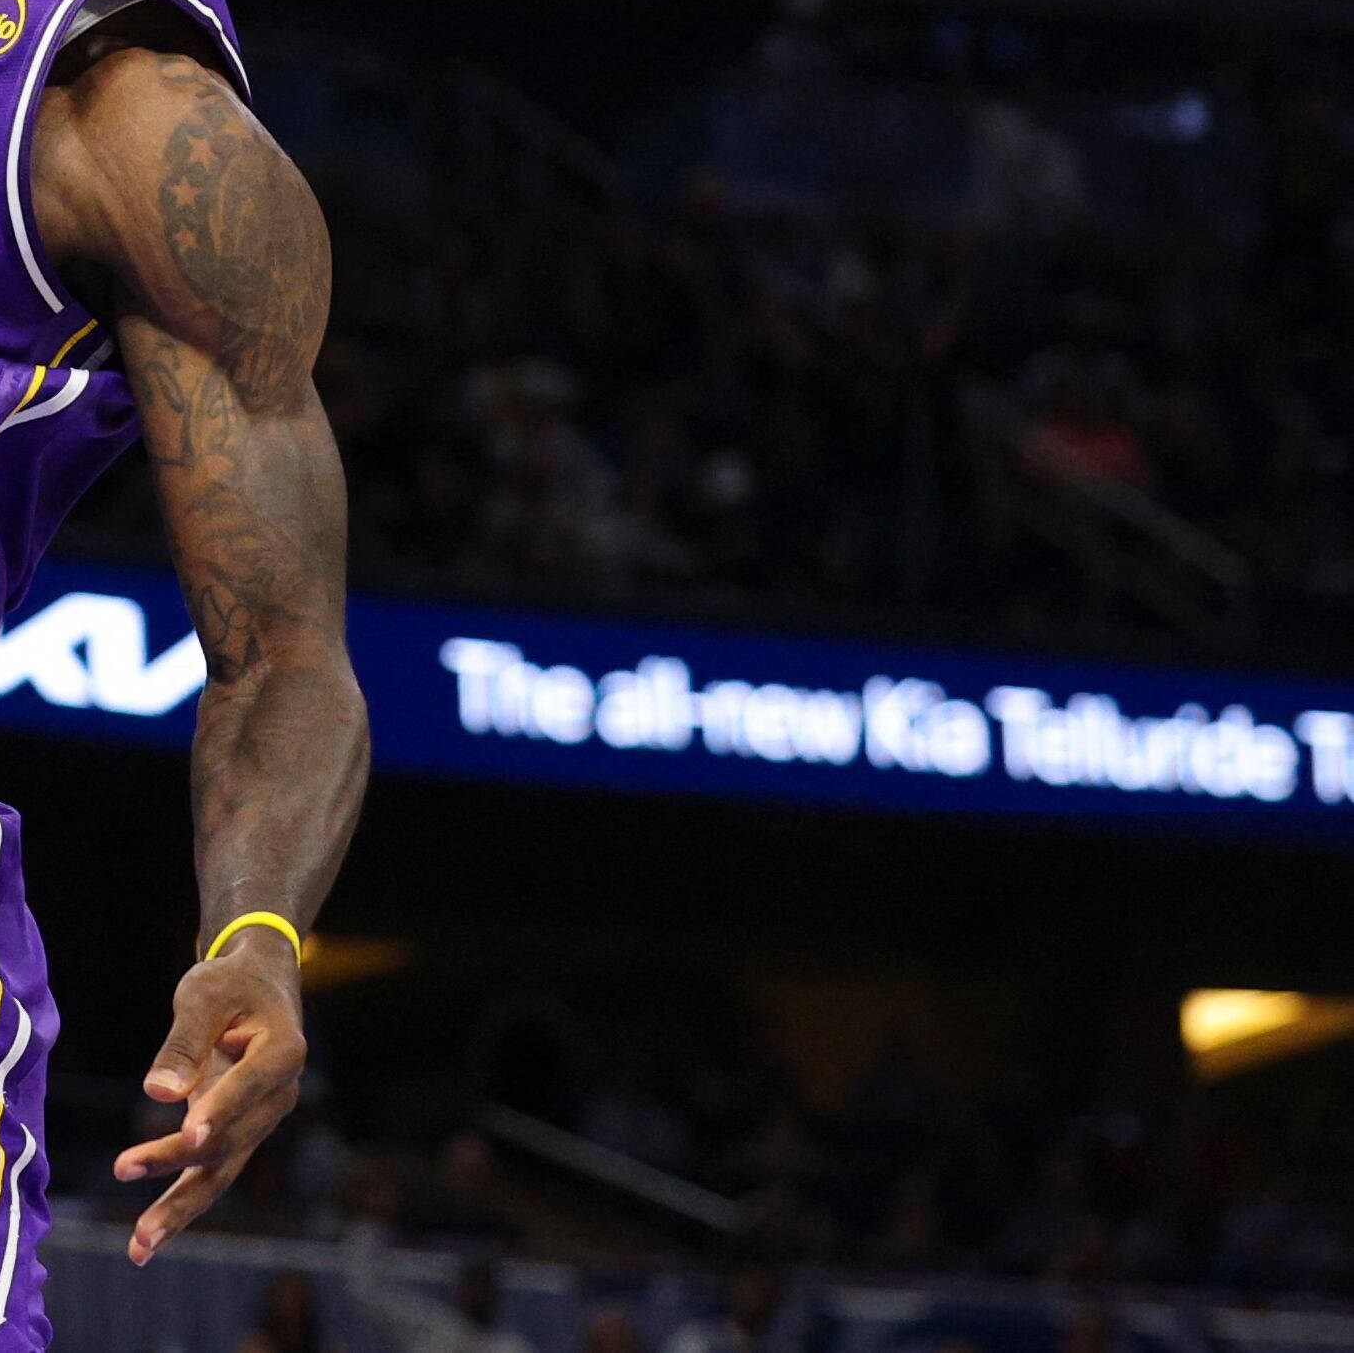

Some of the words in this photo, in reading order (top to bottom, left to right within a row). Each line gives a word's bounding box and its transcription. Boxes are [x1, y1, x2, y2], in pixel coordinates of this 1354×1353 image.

[439, 637, 595, 744] The
[596, 655, 861, 765] all-new
[862, 674, 990, 777] Kia
[985, 685, 1299, 802] Telluride
